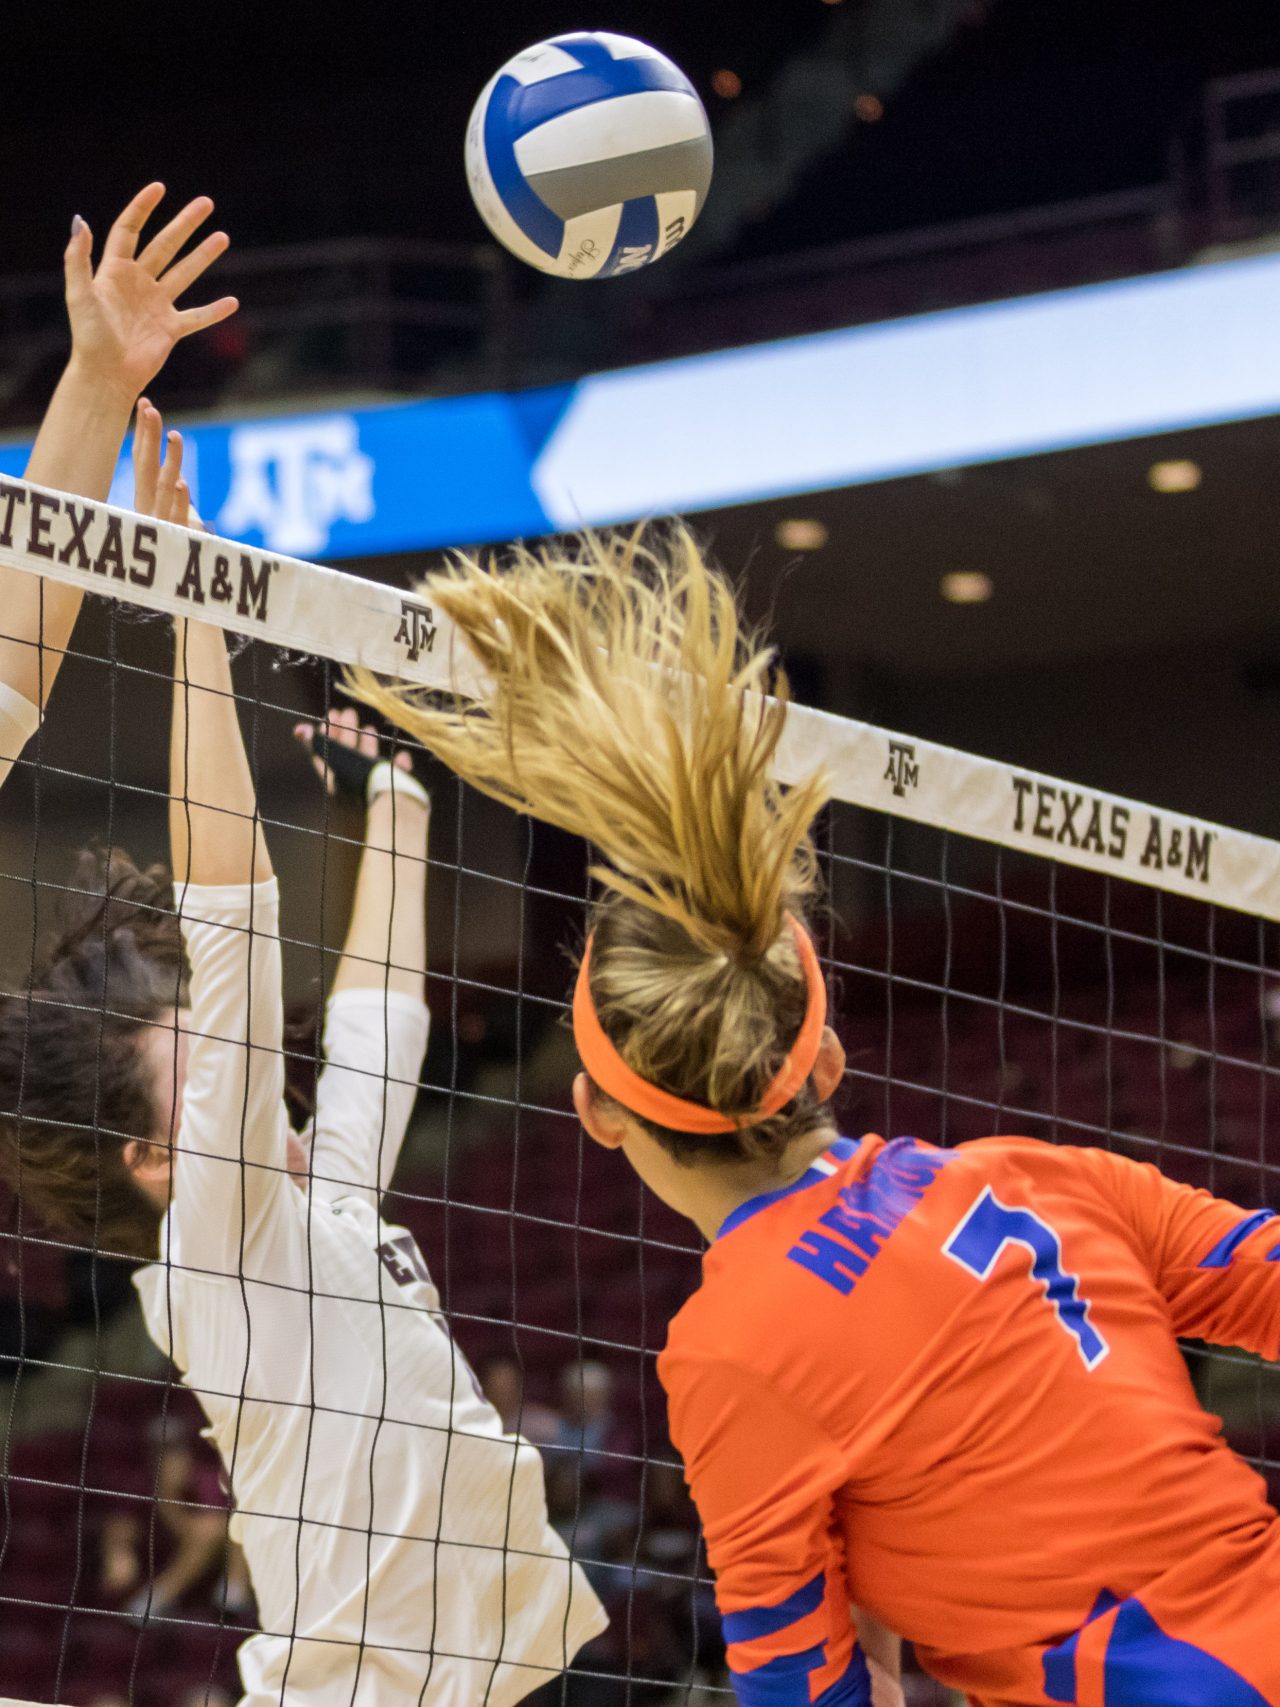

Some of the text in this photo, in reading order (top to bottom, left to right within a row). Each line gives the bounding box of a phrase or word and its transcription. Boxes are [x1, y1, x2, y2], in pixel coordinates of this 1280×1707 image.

[175, 537, 273, 621] A&M
[1012, 776, 1212, 882] TEXAS A&M
[941, 1184, 1110, 1372] 7
